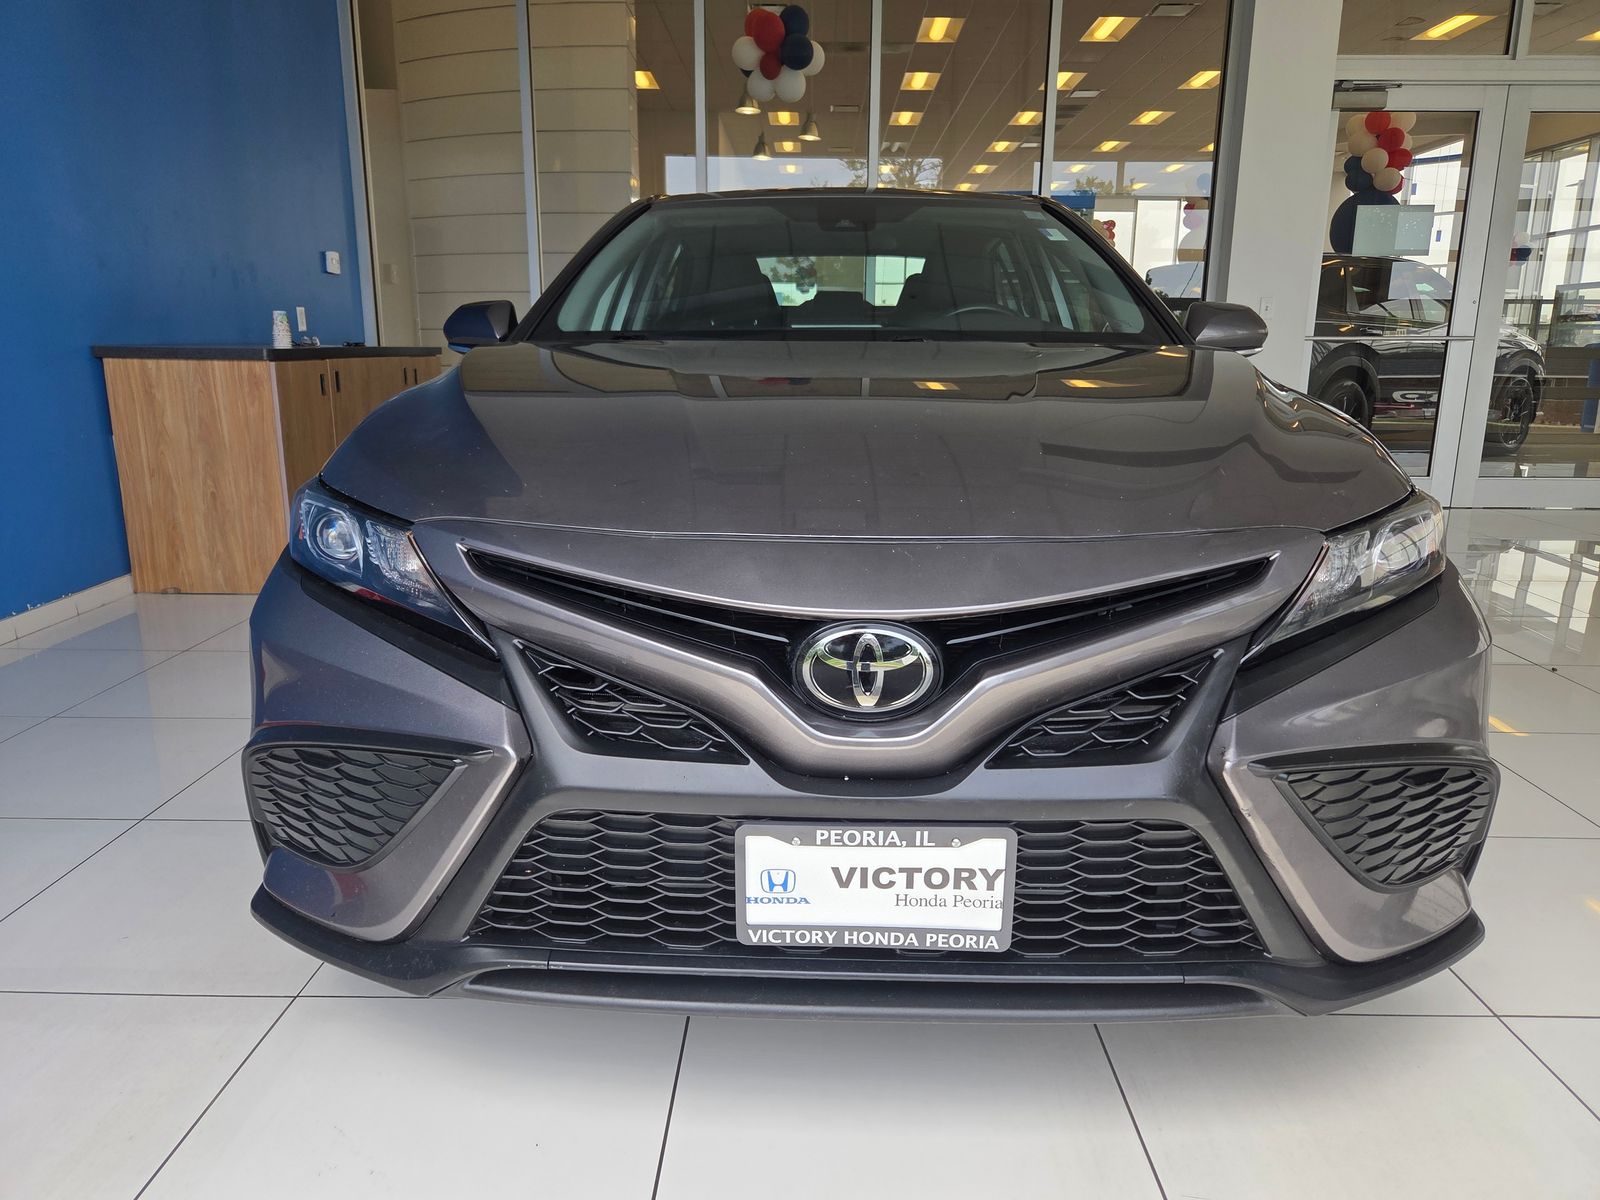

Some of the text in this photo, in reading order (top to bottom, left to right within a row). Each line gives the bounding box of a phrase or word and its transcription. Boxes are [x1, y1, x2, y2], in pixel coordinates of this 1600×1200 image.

[816, 829, 936, 848] PEORIA, IL
[831, 867, 1005, 891] VICTORY
[745, 896, 811, 905] HONDA
[895, 894, 1004, 909] Honda Peoria
[748, 929, 999, 950] VICTORY HONDA PEORIA
